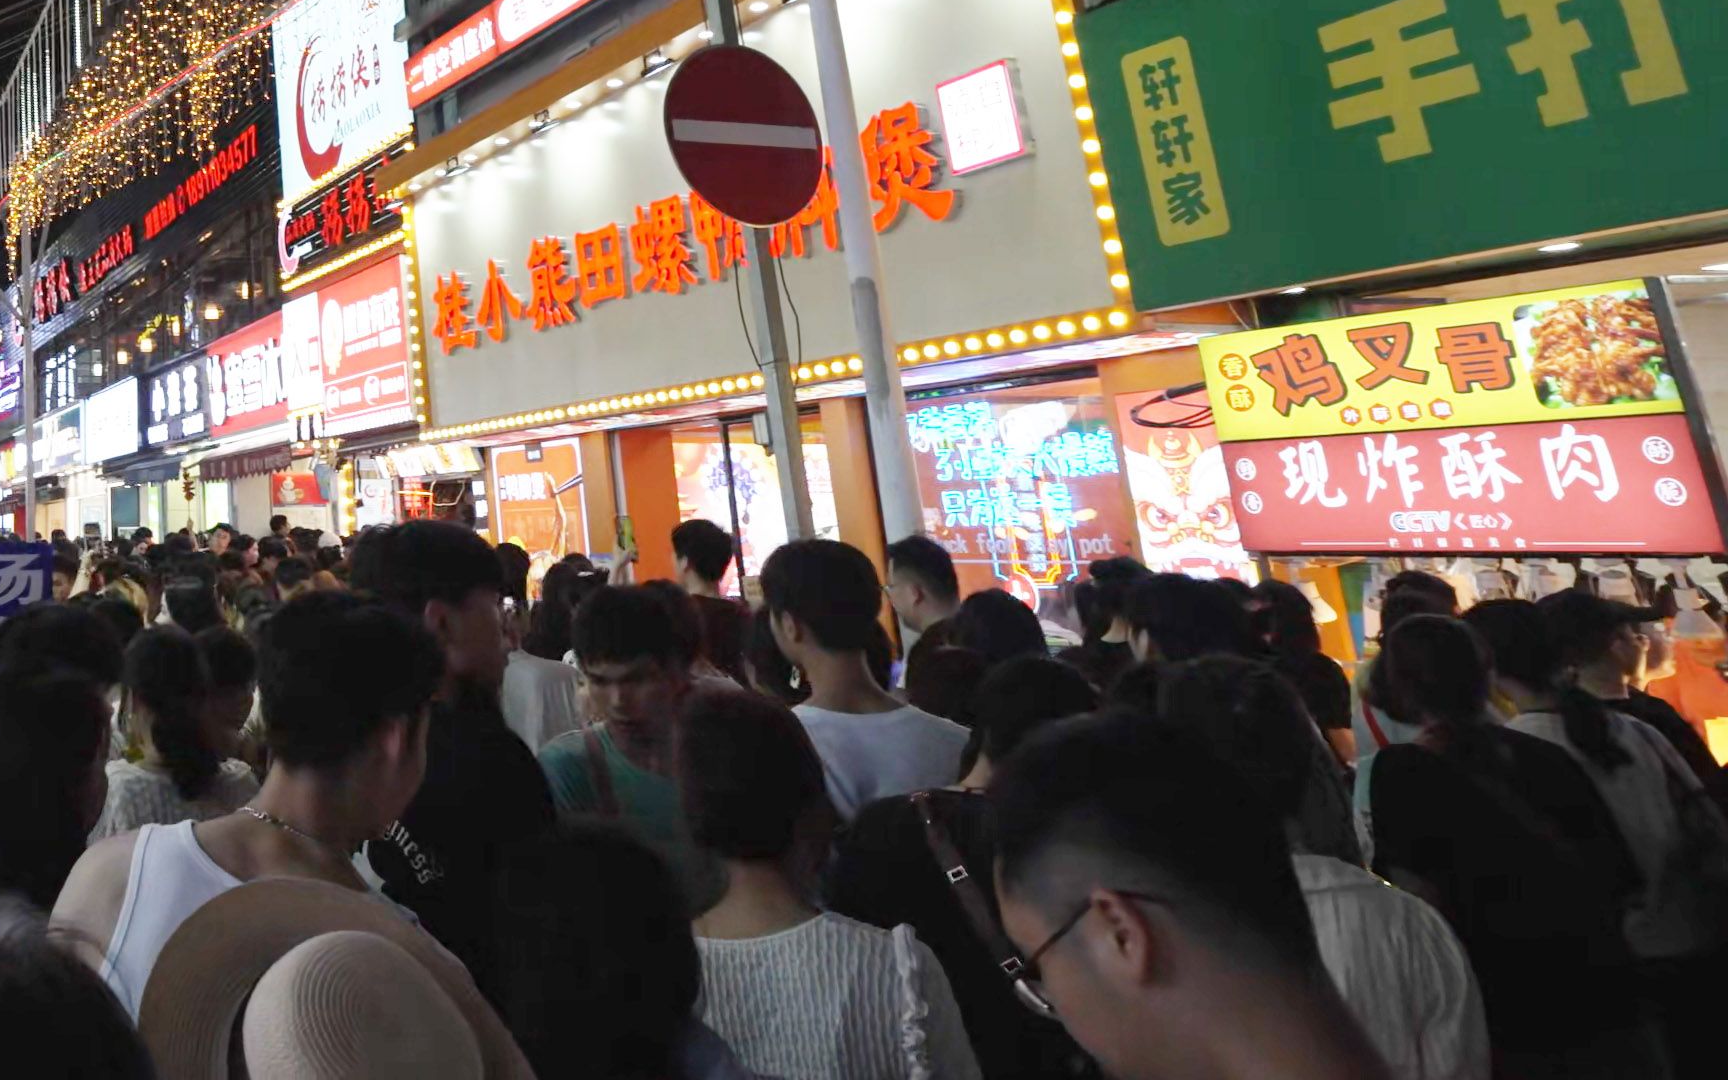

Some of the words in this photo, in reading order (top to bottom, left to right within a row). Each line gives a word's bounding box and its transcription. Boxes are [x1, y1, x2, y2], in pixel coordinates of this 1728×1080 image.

[409, 16, 496, 94] 二楼空调座位
[1138, 57, 1212, 227] 轩轩家
[1251, 321, 1517, 417] 鸡叉骨
[1277, 423, 1620, 510] 现炸酥肉
[1079, 534, 1116, 561] pot
